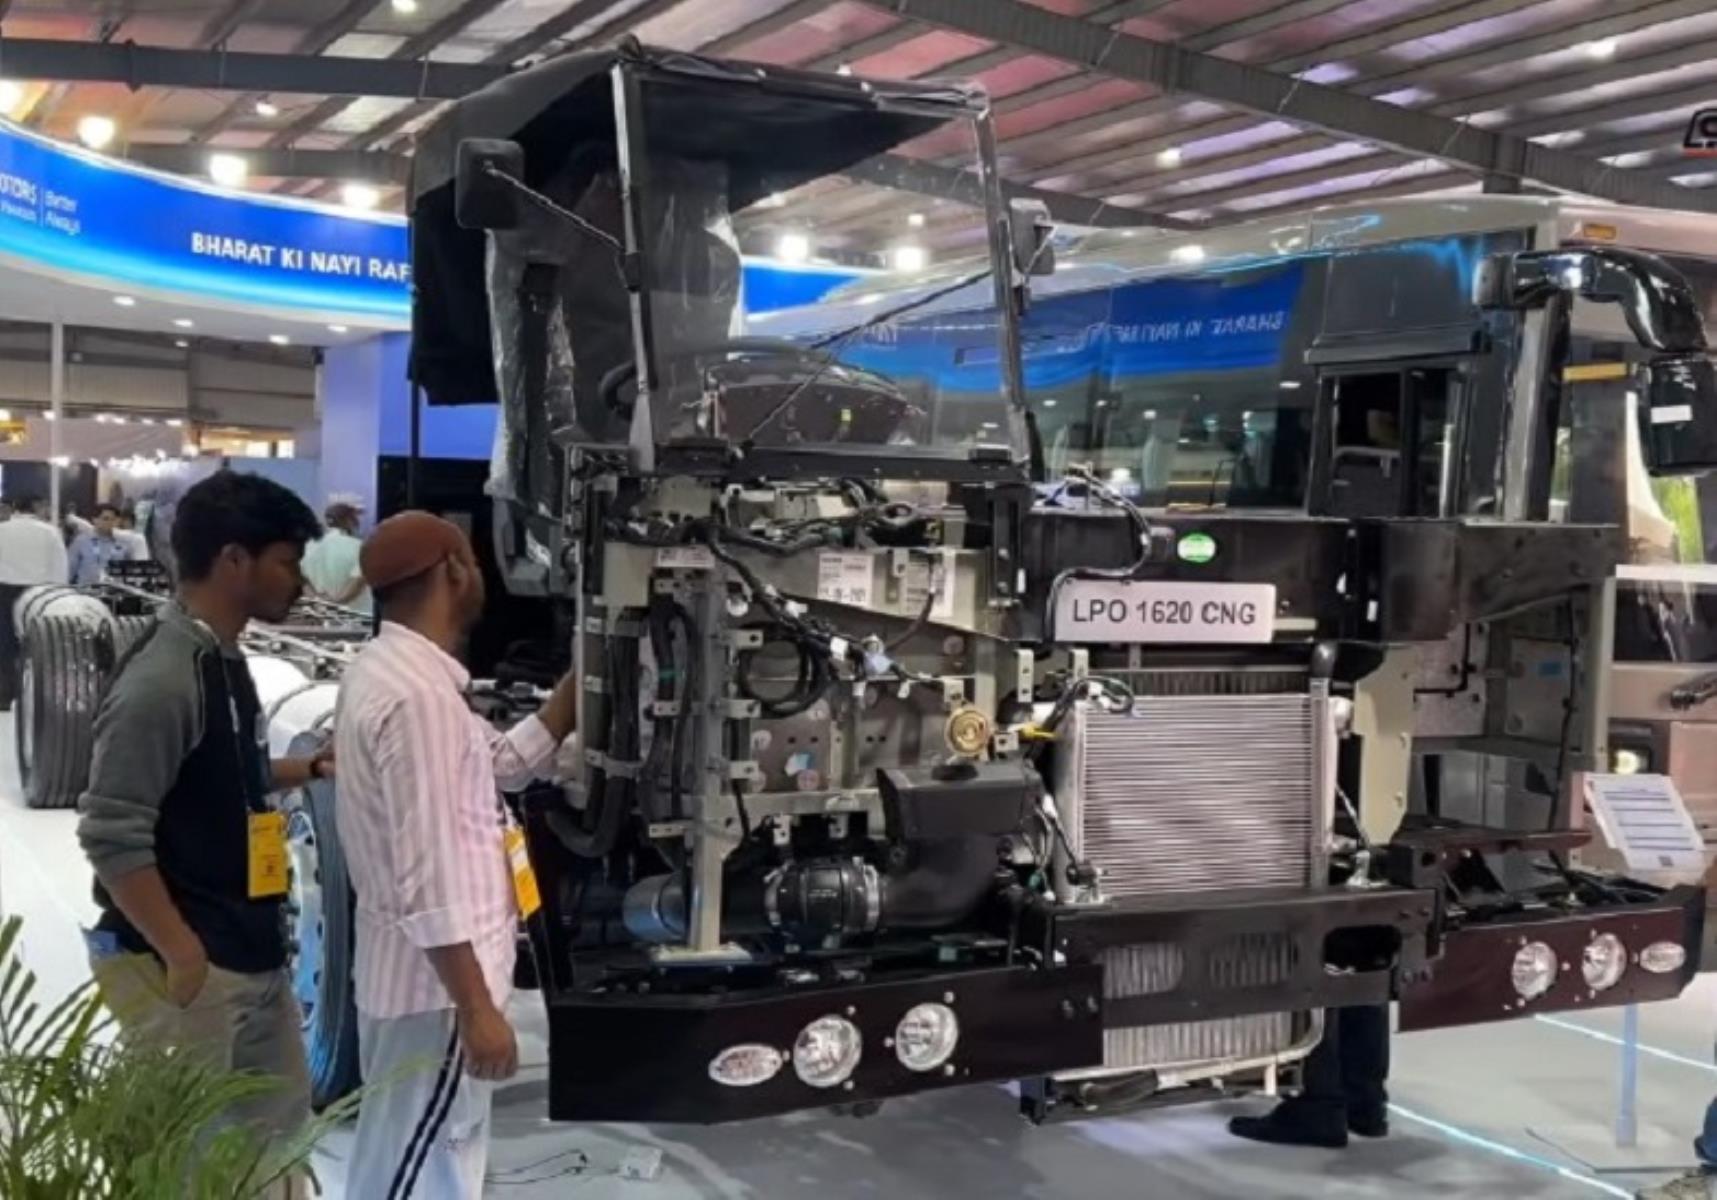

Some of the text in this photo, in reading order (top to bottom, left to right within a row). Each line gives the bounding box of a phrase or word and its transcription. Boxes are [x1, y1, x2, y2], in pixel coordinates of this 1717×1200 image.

[191, 232, 275, 266] BHARAT
[280, 248, 303, 269] KI
[310, 251, 361, 276] NAYI
[1073, 599, 1256, 625] LPO 1620 CNG
